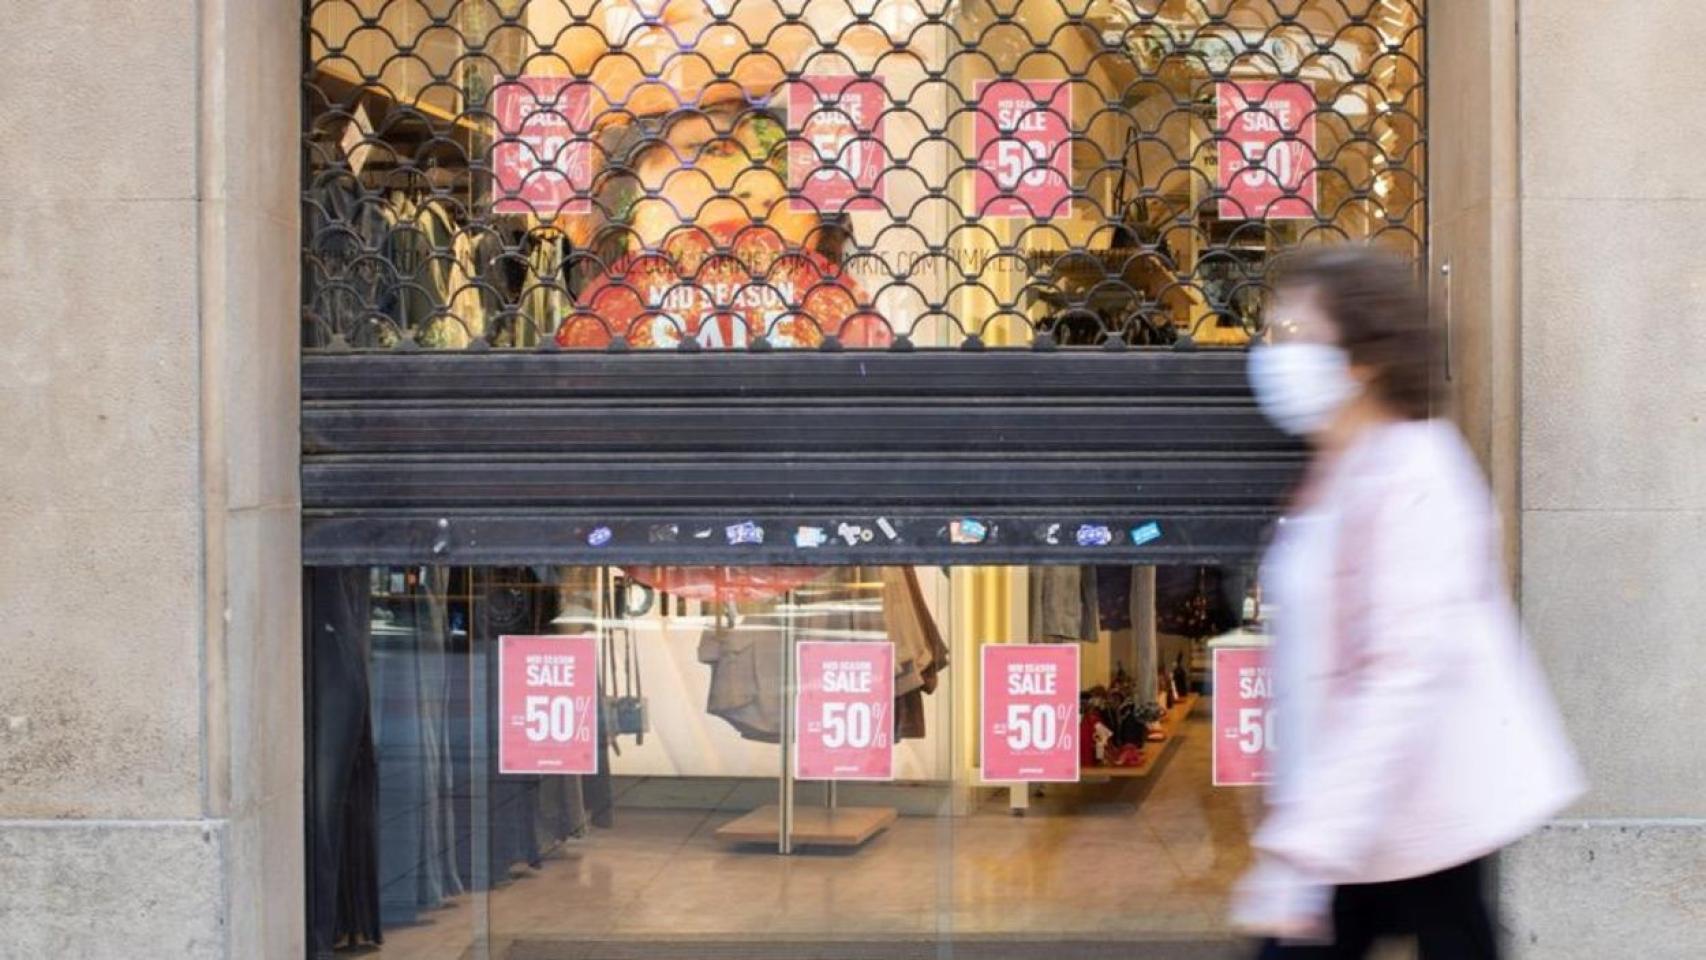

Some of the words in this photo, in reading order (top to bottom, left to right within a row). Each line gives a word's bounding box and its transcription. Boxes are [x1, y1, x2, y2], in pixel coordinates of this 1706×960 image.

[998, 109, 1047, 131] SALE
[1241, 109, 1291, 132] SALE
[649, 284, 694, 309] MID
[702, 282, 795, 309] SEASON
[525, 665, 576, 688] SALE
[822, 671, 872, 693] SALE
[1007, 673, 1057, 695] SALE
